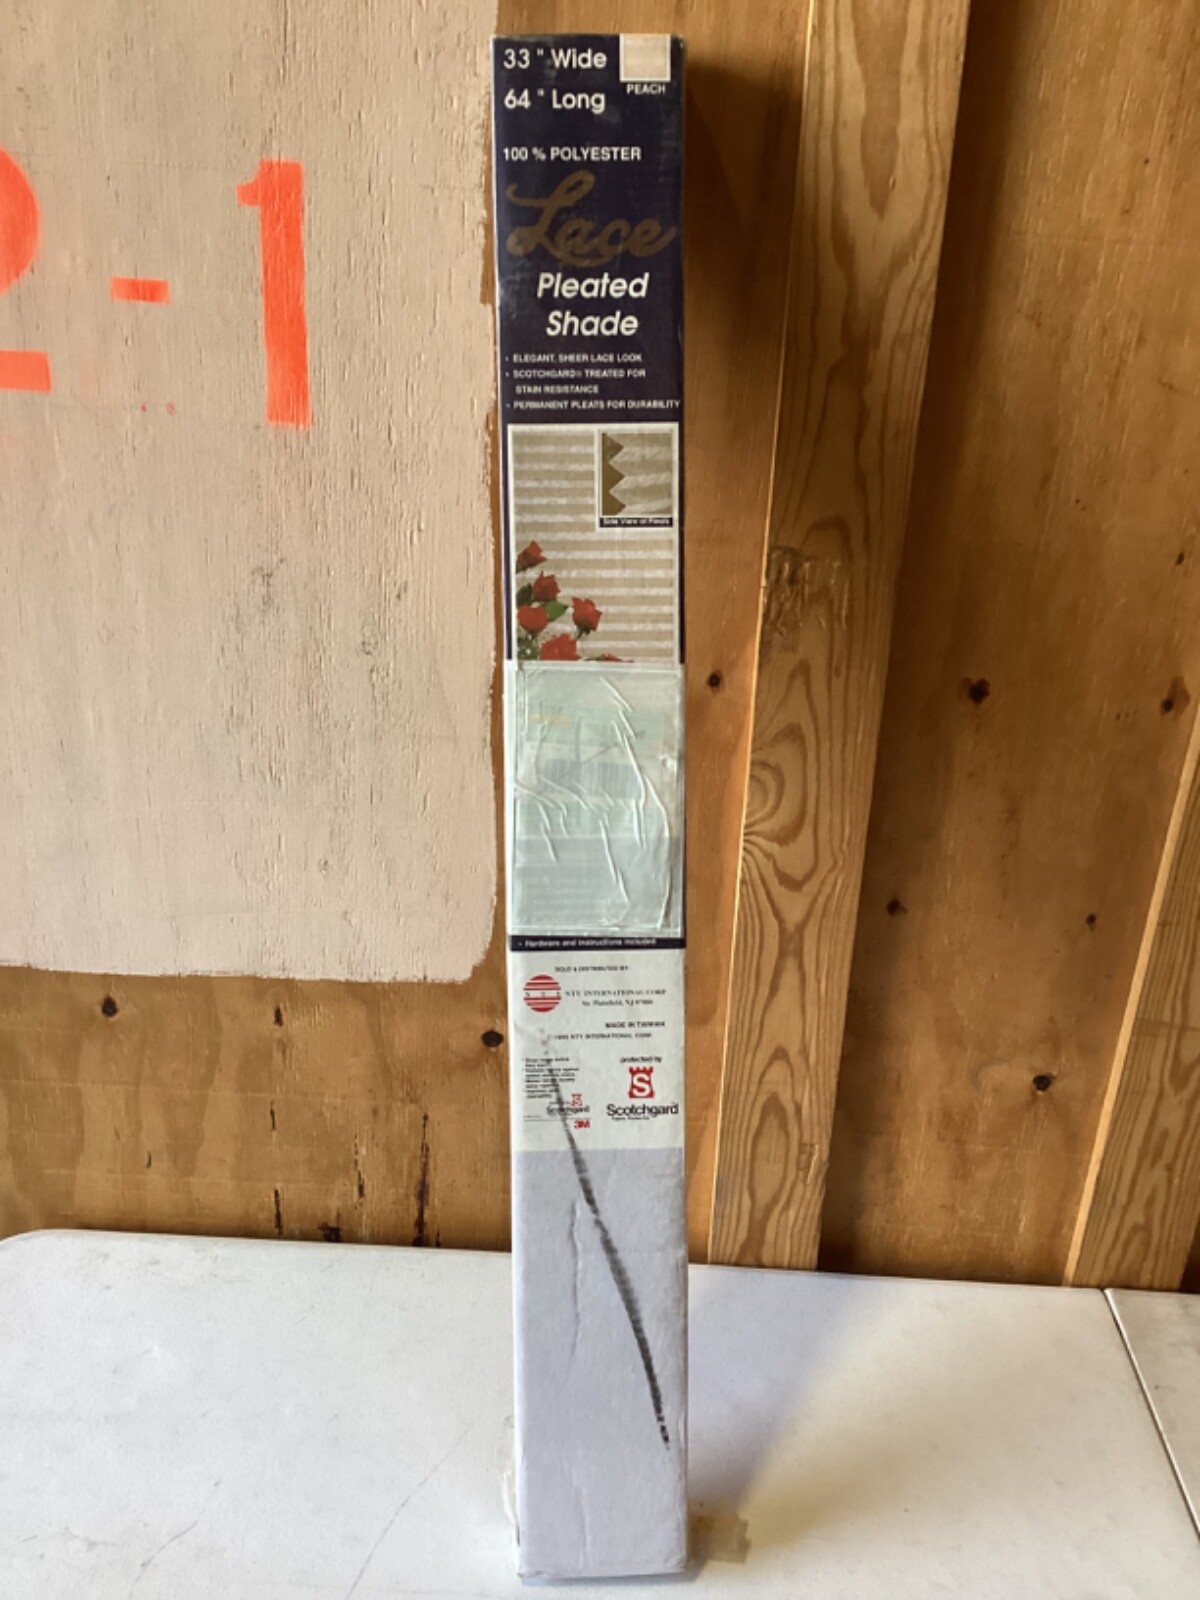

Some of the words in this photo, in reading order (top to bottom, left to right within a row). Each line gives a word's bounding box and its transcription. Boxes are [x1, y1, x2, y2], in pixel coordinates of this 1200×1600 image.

[503, 48, 530, 69] 33
[551, 48, 607, 69] Wide
[626, 83, 667, 95] PEACH
[504, 88, 531, 109] 64
[552, 88, 606, 114] Long
[504, 147, 528, 161] 100
[550, 147, 642, 161] POLYESTER
[506, 169, 677, 268] Lace
[537, 272, 650, 299] Pleated
[546, 310, 639, 336] Shade
[558, 353, 589, 363] SHEER
[590, 353, 615, 363] LACE
[617, 353, 643, 362] LOOK
[584, 368, 626, 378] TREATED
[627, 367, 647, 378] FOR
[515, 384, 542, 395] STAIN
[543, 384, 600, 394] RESISTANCE
[513, 400, 569, 410] PERMANENT
[570, 400, 605, 410] PLEATS
[607, 399, 626, 409] FOR
[627, 399, 681, 409] DURABILITY
[525, 939, 560, 947] Hardware
[620, 1056, 653, 1064] protected
[606, 1103, 679, 1117] Scotchgard
